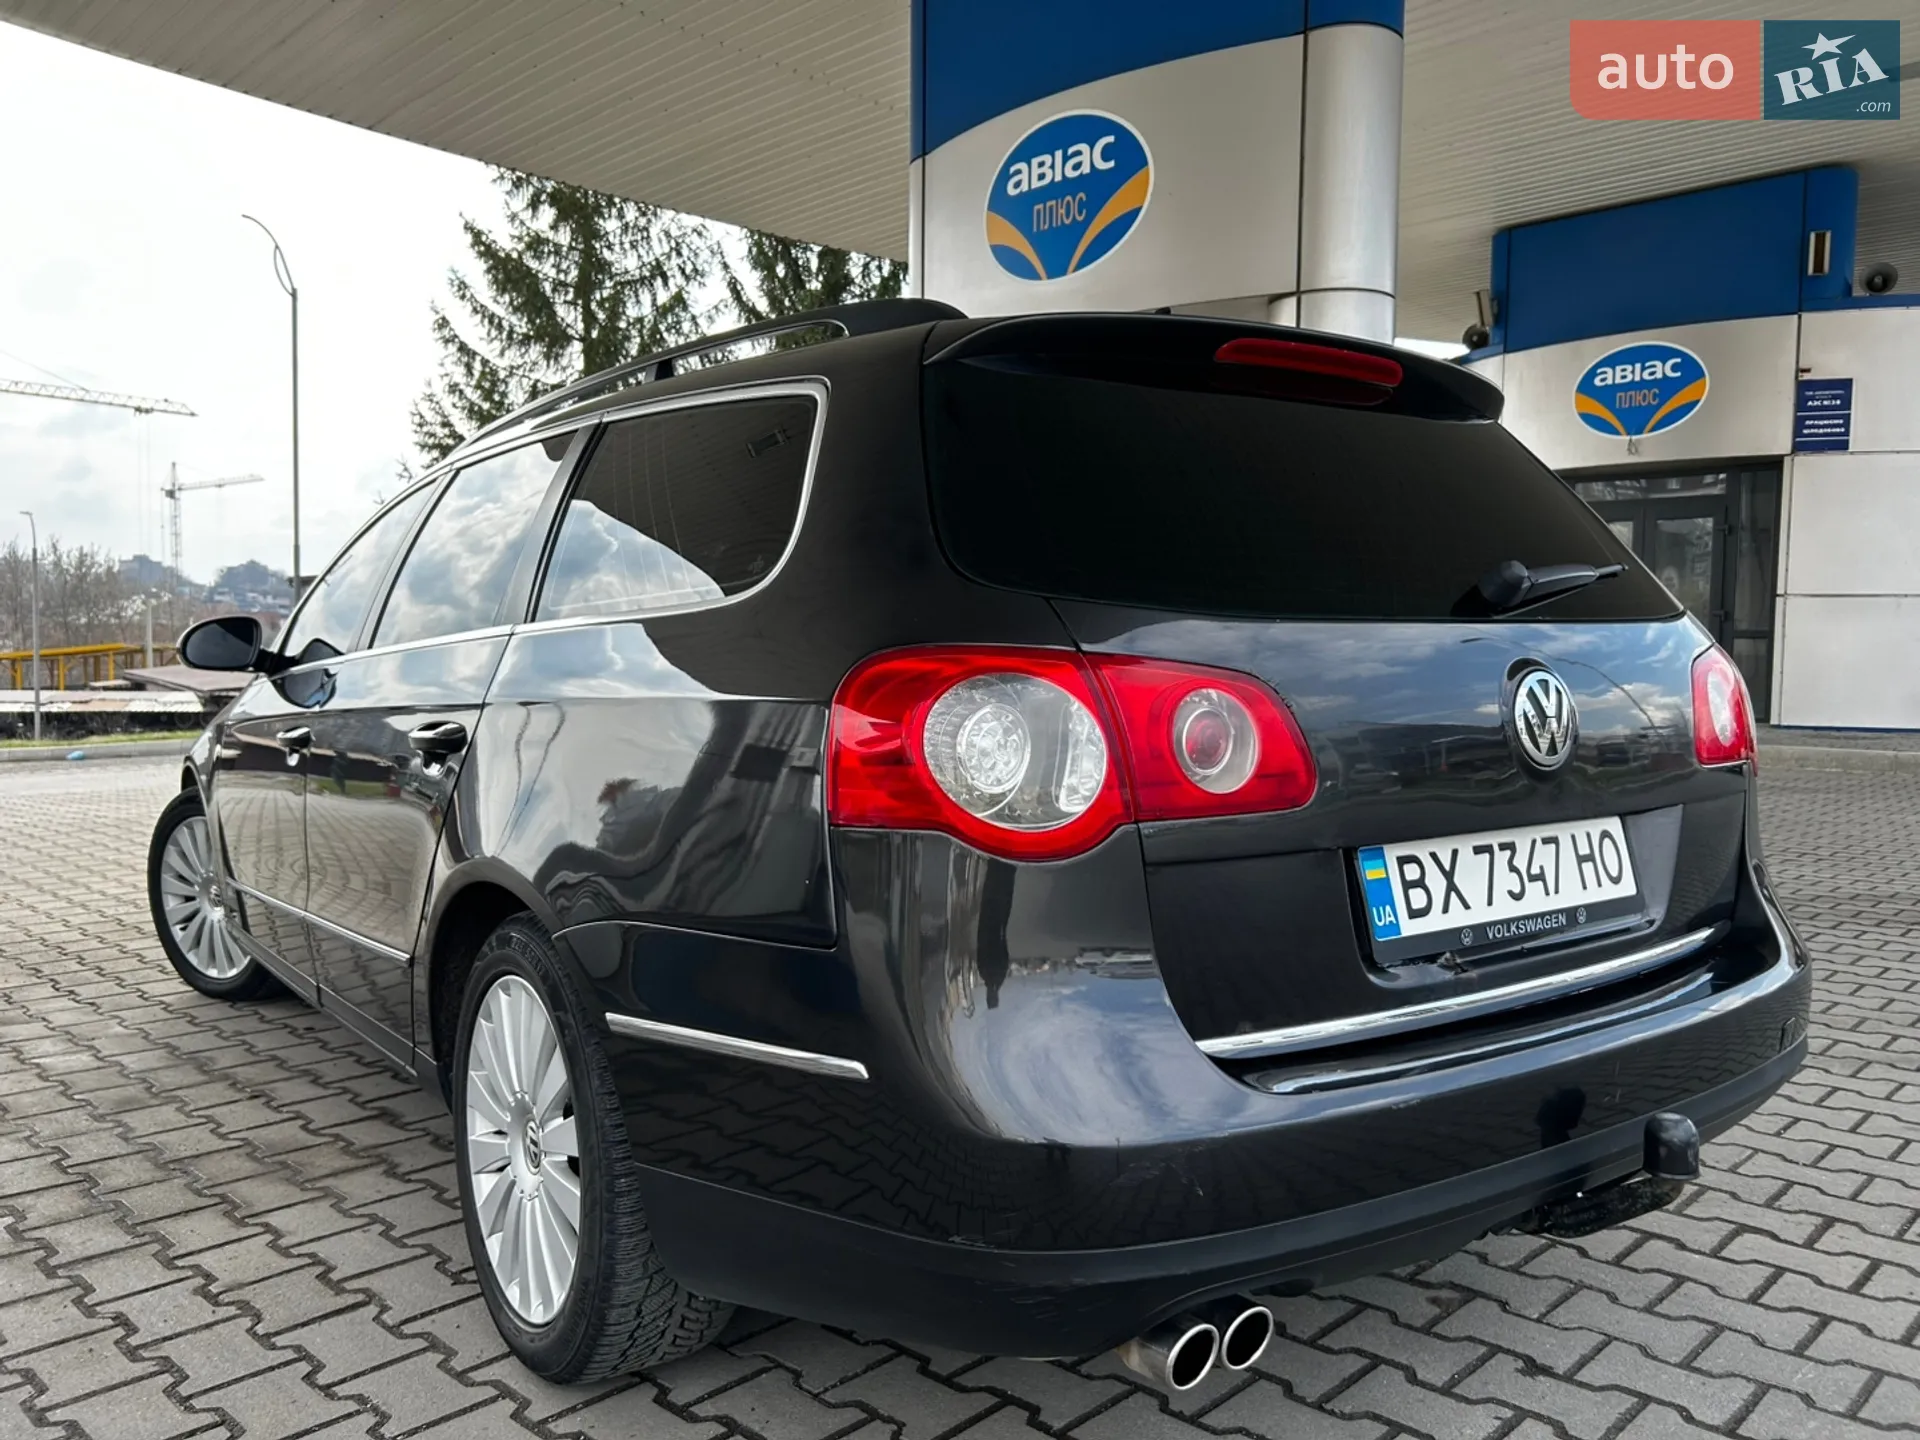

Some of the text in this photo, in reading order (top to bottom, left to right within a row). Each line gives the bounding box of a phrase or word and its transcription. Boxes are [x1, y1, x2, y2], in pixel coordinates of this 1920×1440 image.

[1033, 192, 1087, 233] ПЛЮС
[1395, 829, 1623, 920] BX 7347 HO
[1373, 904, 1397, 927] UA
[1486, 912, 1567, 940] VOLKSWAGEN
